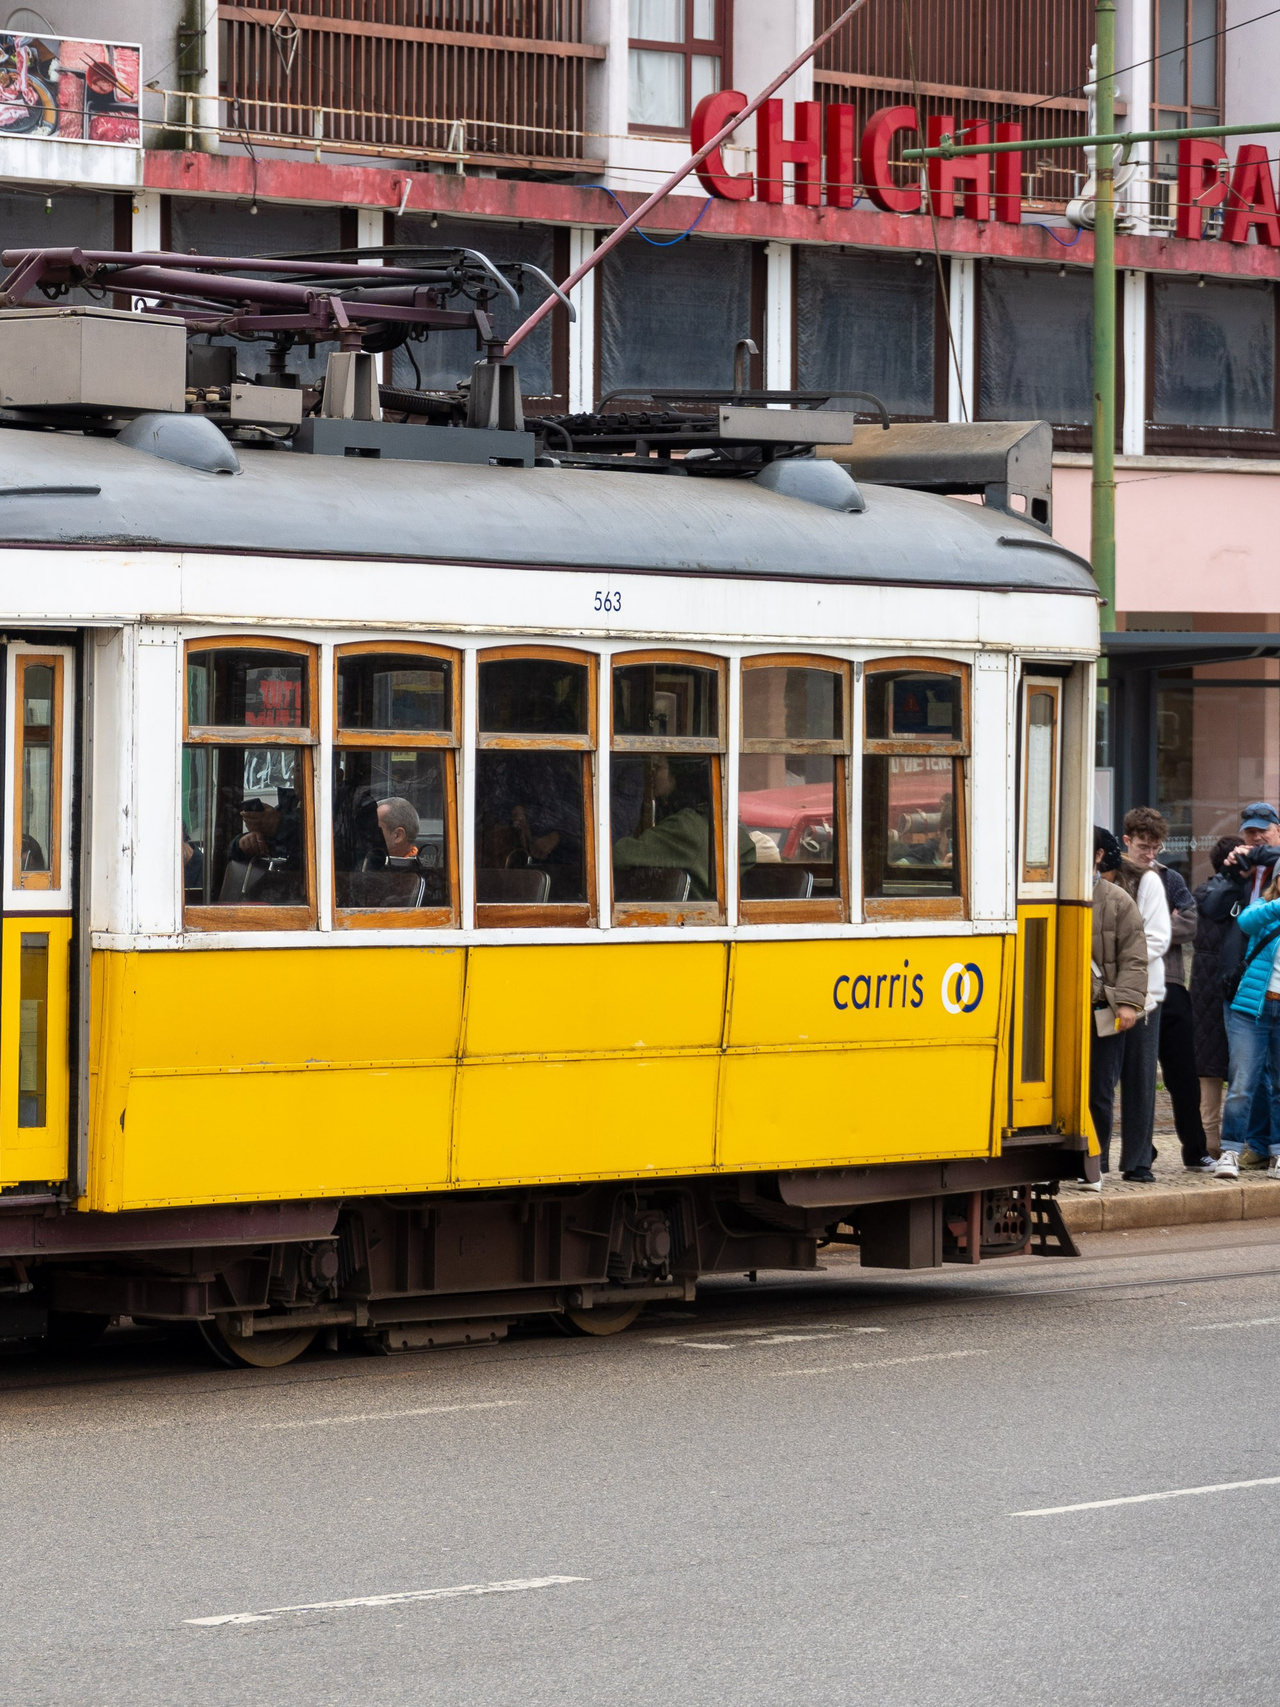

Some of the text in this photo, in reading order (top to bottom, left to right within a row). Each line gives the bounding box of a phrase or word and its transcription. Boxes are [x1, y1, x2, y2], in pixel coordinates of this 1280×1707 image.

[691, 89, 1020, 223] CHICHI
[593, 590, 622, 613] 563
[833, 959, 924, 1010] carris
